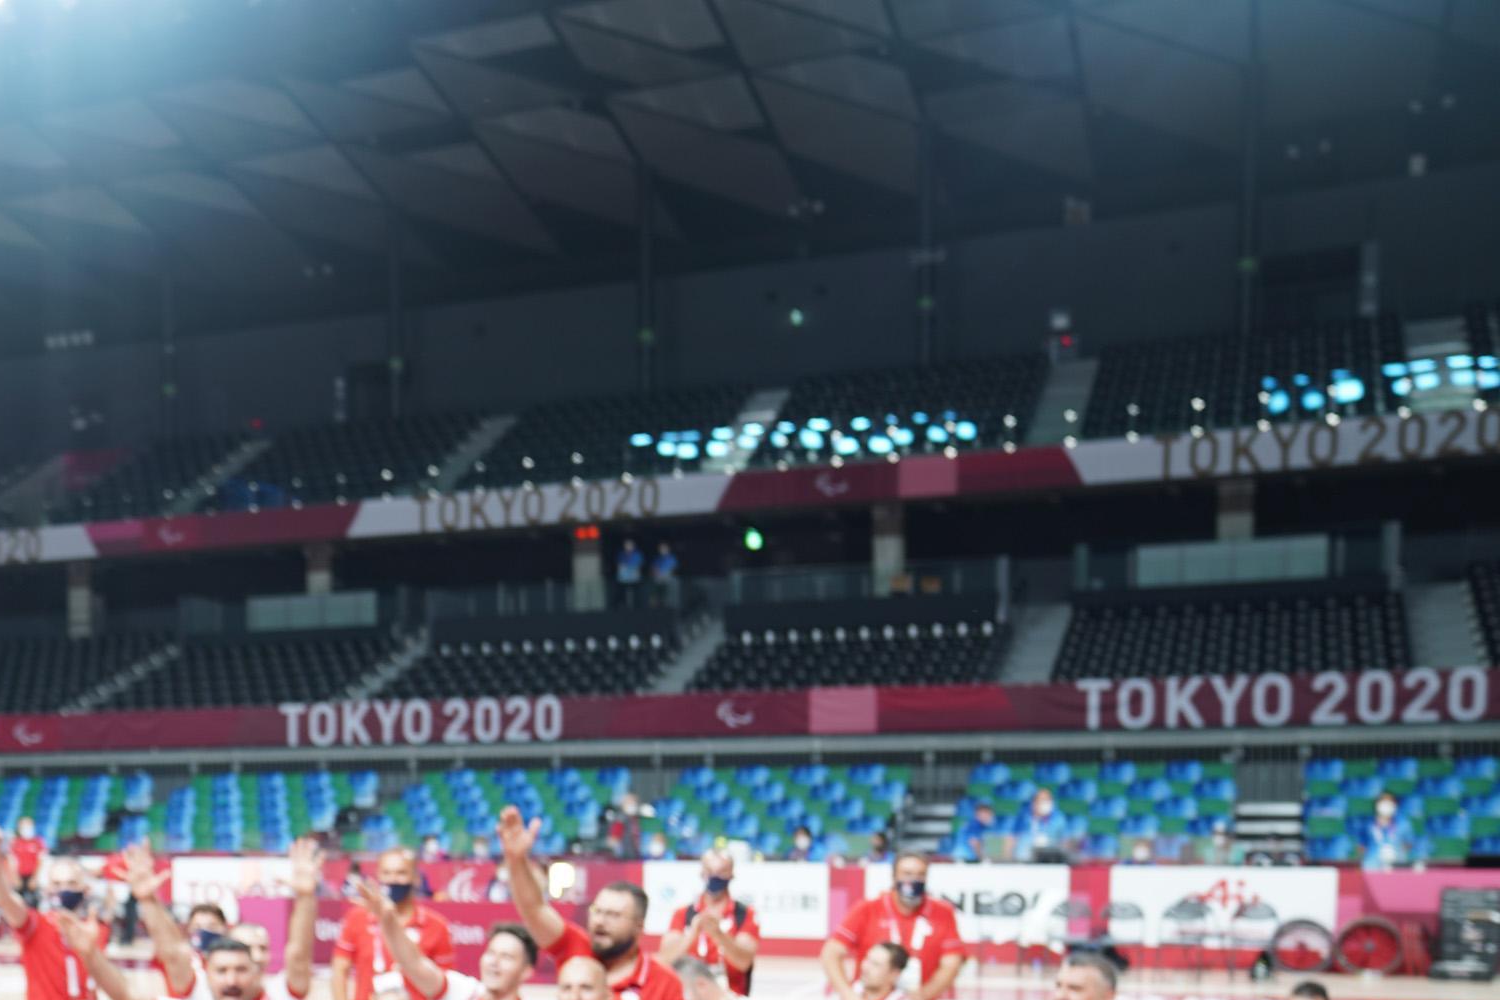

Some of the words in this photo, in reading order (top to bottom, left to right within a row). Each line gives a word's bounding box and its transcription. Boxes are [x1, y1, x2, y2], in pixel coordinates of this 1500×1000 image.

[1155, 418, 1338, 480] TOKYO
[1358, 409, 1500, 465] 2020
[413, 484, 544, 533] TOKYO
[559, 477, 659, 522] 2020
[279, 698, 432, 747] TOKYO
[442, 694, 563, 743] 2020
[1076, 672, 1294, 731] TOKYO
[1309, 666, 1489, 725] 2020
